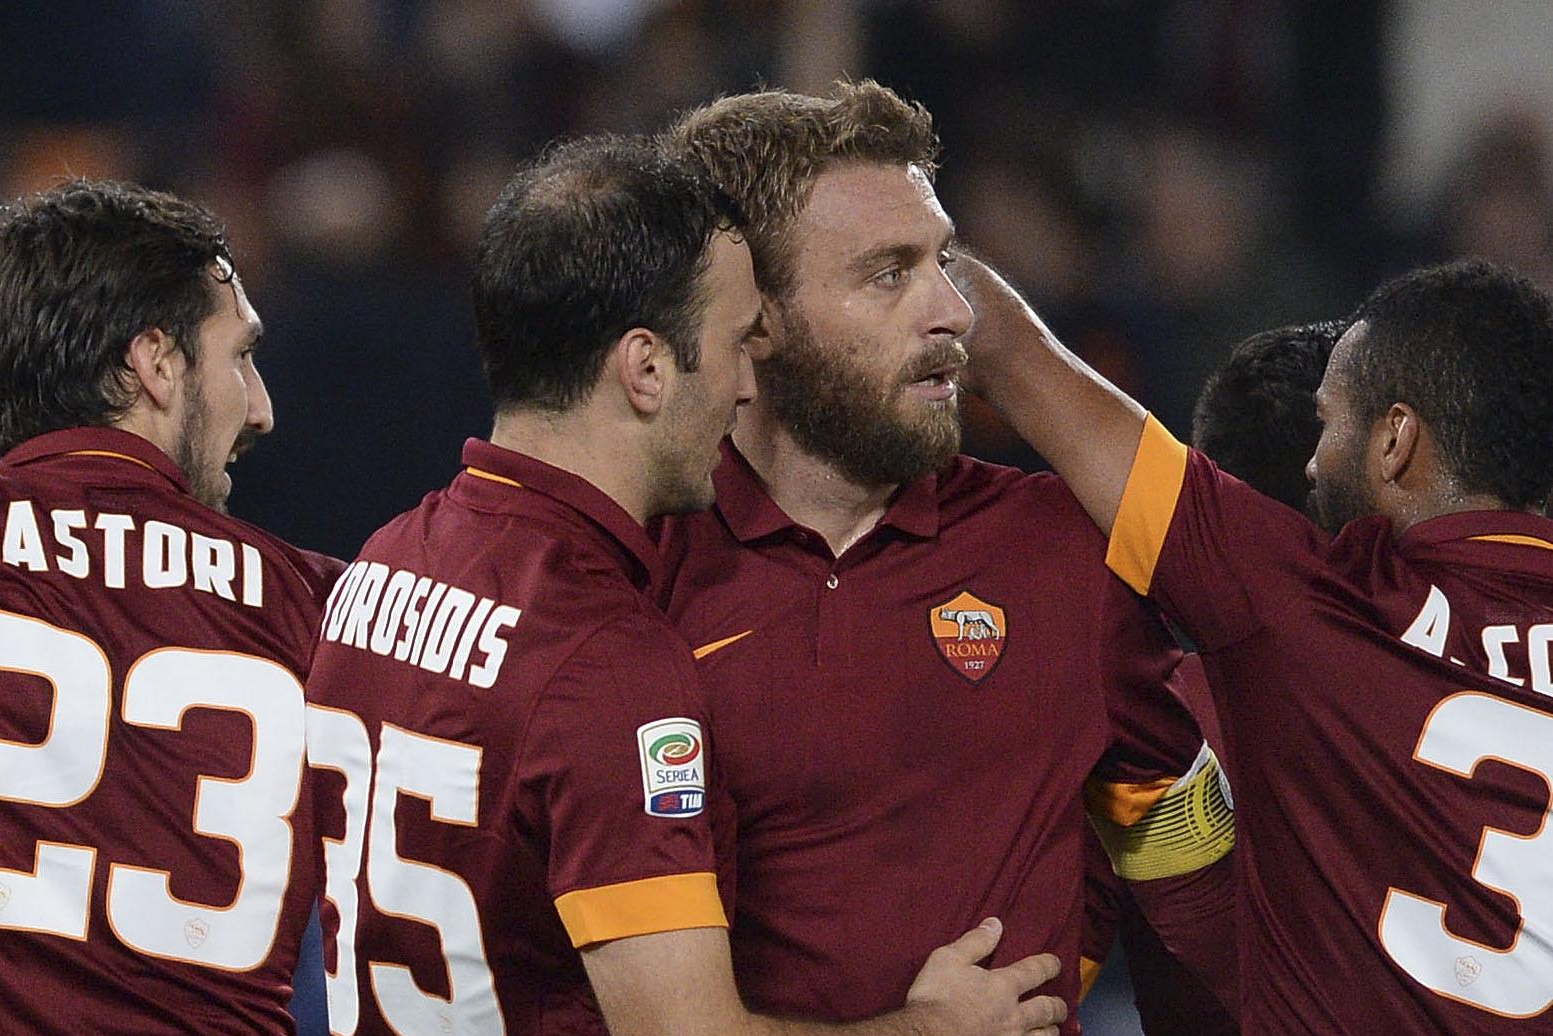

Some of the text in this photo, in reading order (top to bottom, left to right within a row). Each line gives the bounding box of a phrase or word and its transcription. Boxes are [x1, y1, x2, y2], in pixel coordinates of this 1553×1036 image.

[2, 500, 262, 608] ASTORI
[320, 561, 522, 689] OROSIDIS
[946, 643, 999, 657] ROMA
[964, 660, 985, 670] 1927
[1378, 690, 1553, 1019] 3
